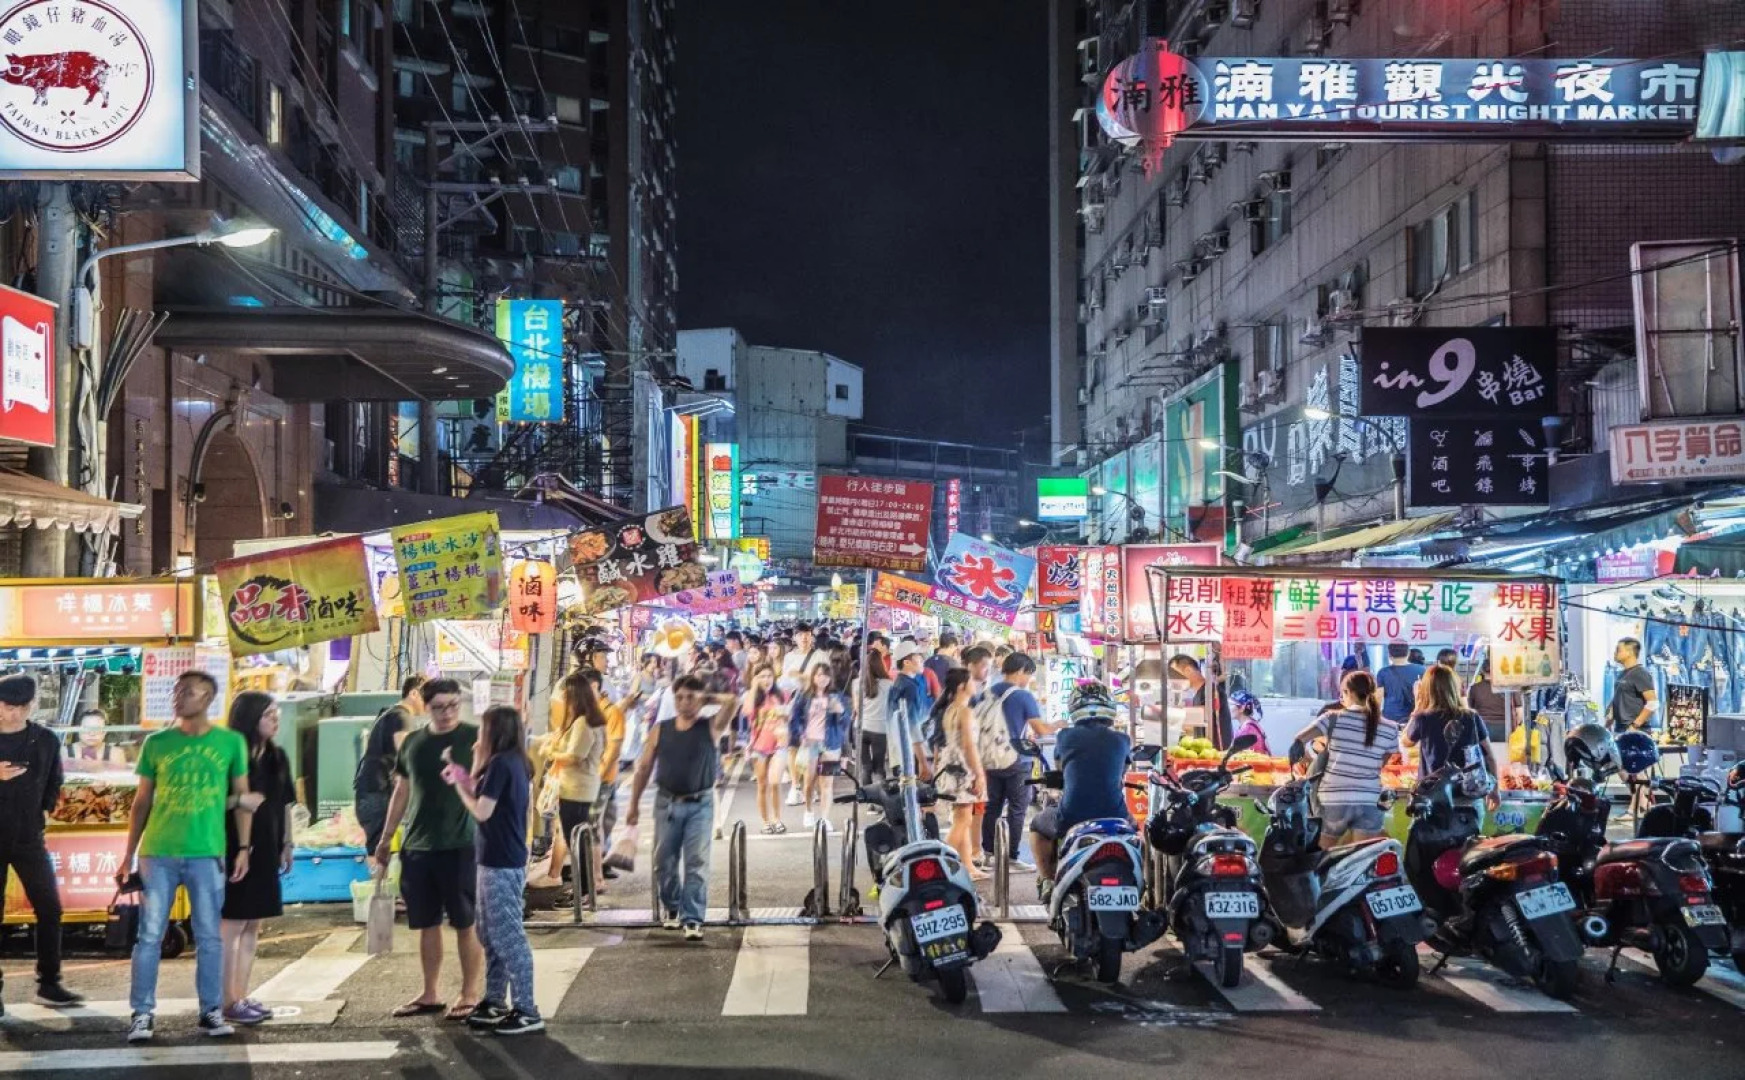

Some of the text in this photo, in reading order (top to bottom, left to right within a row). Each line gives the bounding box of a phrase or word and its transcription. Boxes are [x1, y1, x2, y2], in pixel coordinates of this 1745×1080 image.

[1112, 73, 1202, 113] 湳雅
[1215, 60, 1700, 102] 湳雅觀光夜市
[4, 101, 48, 136] TAIWAN
[56, 126, 99, 140] BLACK
[1215, 103, 1696, 120] NAN YA TOURIST NIGHT MARKET
[1476, 354, 1542, 405] 串燒
[1508, 384, 1545, 406] Bar
[1624, 424, 1742, 464] 八字算命
[1431, 455, 1450, 493] 酒吧
[519, 574, 544, 622] 滷味
[1168, 577, 1222, 604] 現削
[1250, 577, 1473, 615] 新鮮任選好吃
[1497, 584, 1556, 610] 現削
[1168, 609, 1222, 636] 水果
[1282, 615, 1428, 641] 三包100元
[1497, 616, 1556, 643] 水果
[1208, 900, 1258, 914] A3Z-316
[915, 914, 966, 938] 5HZ-295
